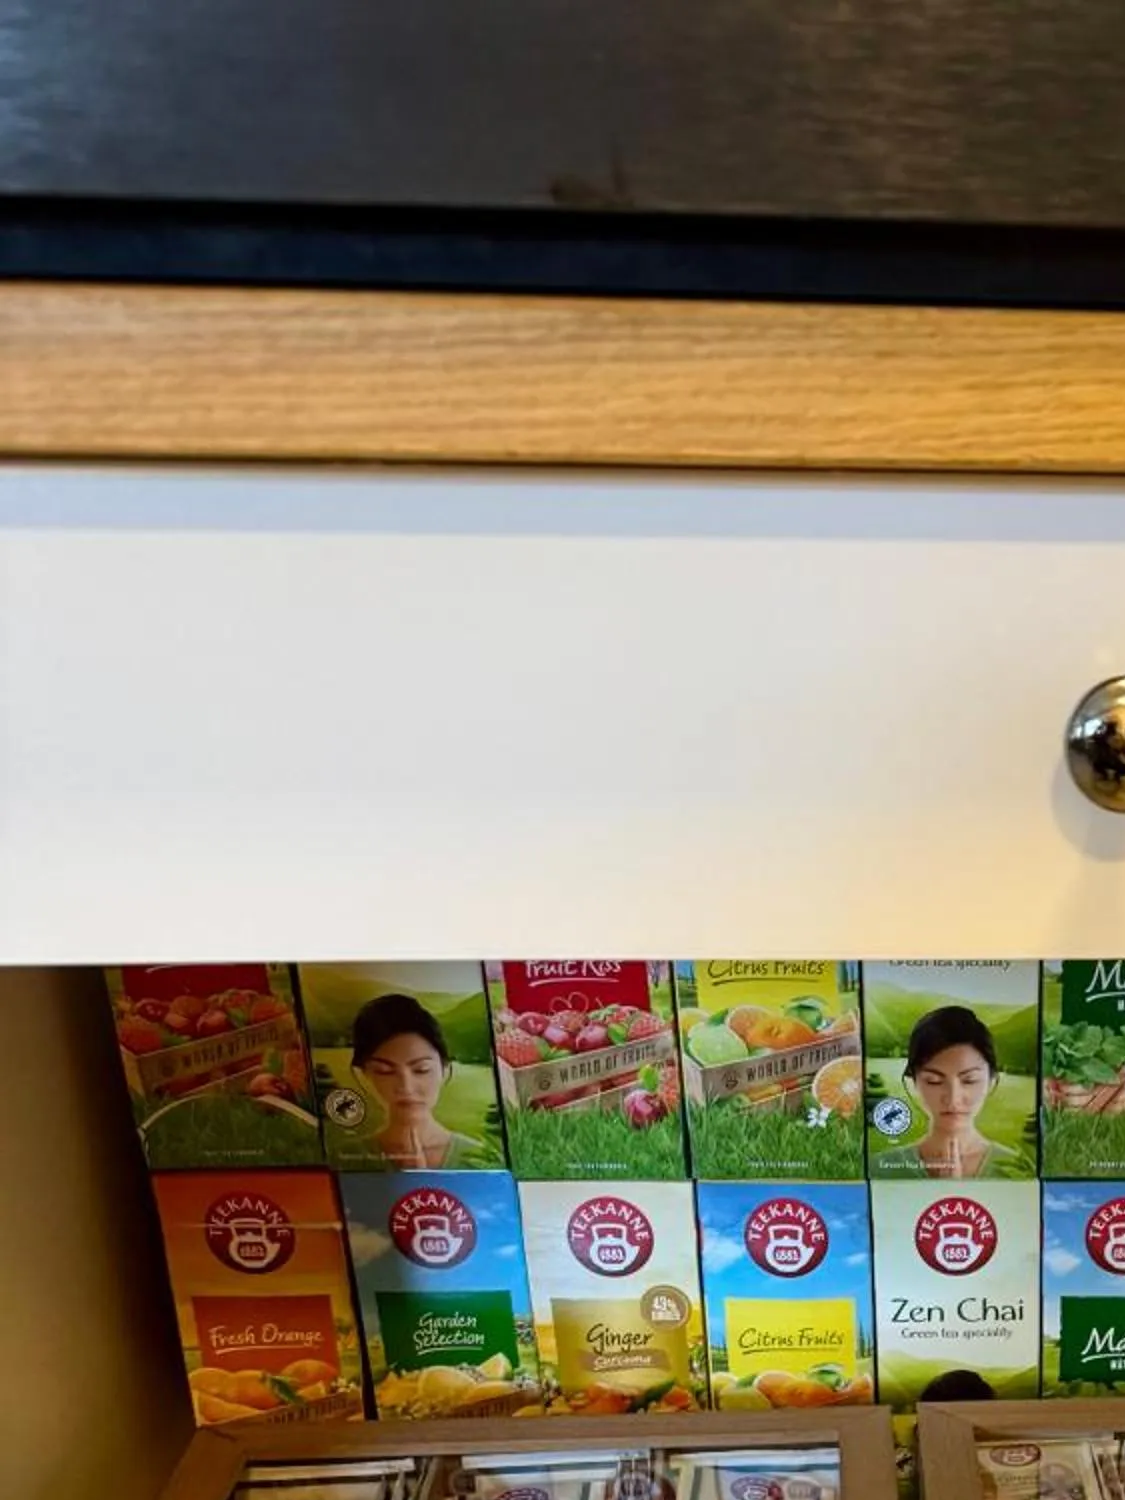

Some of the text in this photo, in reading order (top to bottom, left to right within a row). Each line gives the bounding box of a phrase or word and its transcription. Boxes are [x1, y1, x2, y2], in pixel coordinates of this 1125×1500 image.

[707, 960, 768, 978] Citrus
[560, 1061, 600, 1083] WORLD
[605, 1056, 619, 1071] OF
[747, 1060, 788, 1082] WORLD
[393, 1193, 473, 1233] TEEKANNE
[571, 1202, 650, 1241] TEEKANNE
[749, 1203, 825, 1243] TEEKANNE
[919, 1201, 994, 1240] TEEKANNE
[891, 1297, 1024, 1323] Zen Chai
[208, 1323, 324, 1347] Fresh Orange
[419, 1312, 477, 1336] Garden
[900, 1327, 1013, 1340] Green tea speciality
[413, 1330, 484, 1350] Selection
[587, 1324, 653, 1355] Ginger
[738, 1328, 844, 1349] Citrus Fruits
